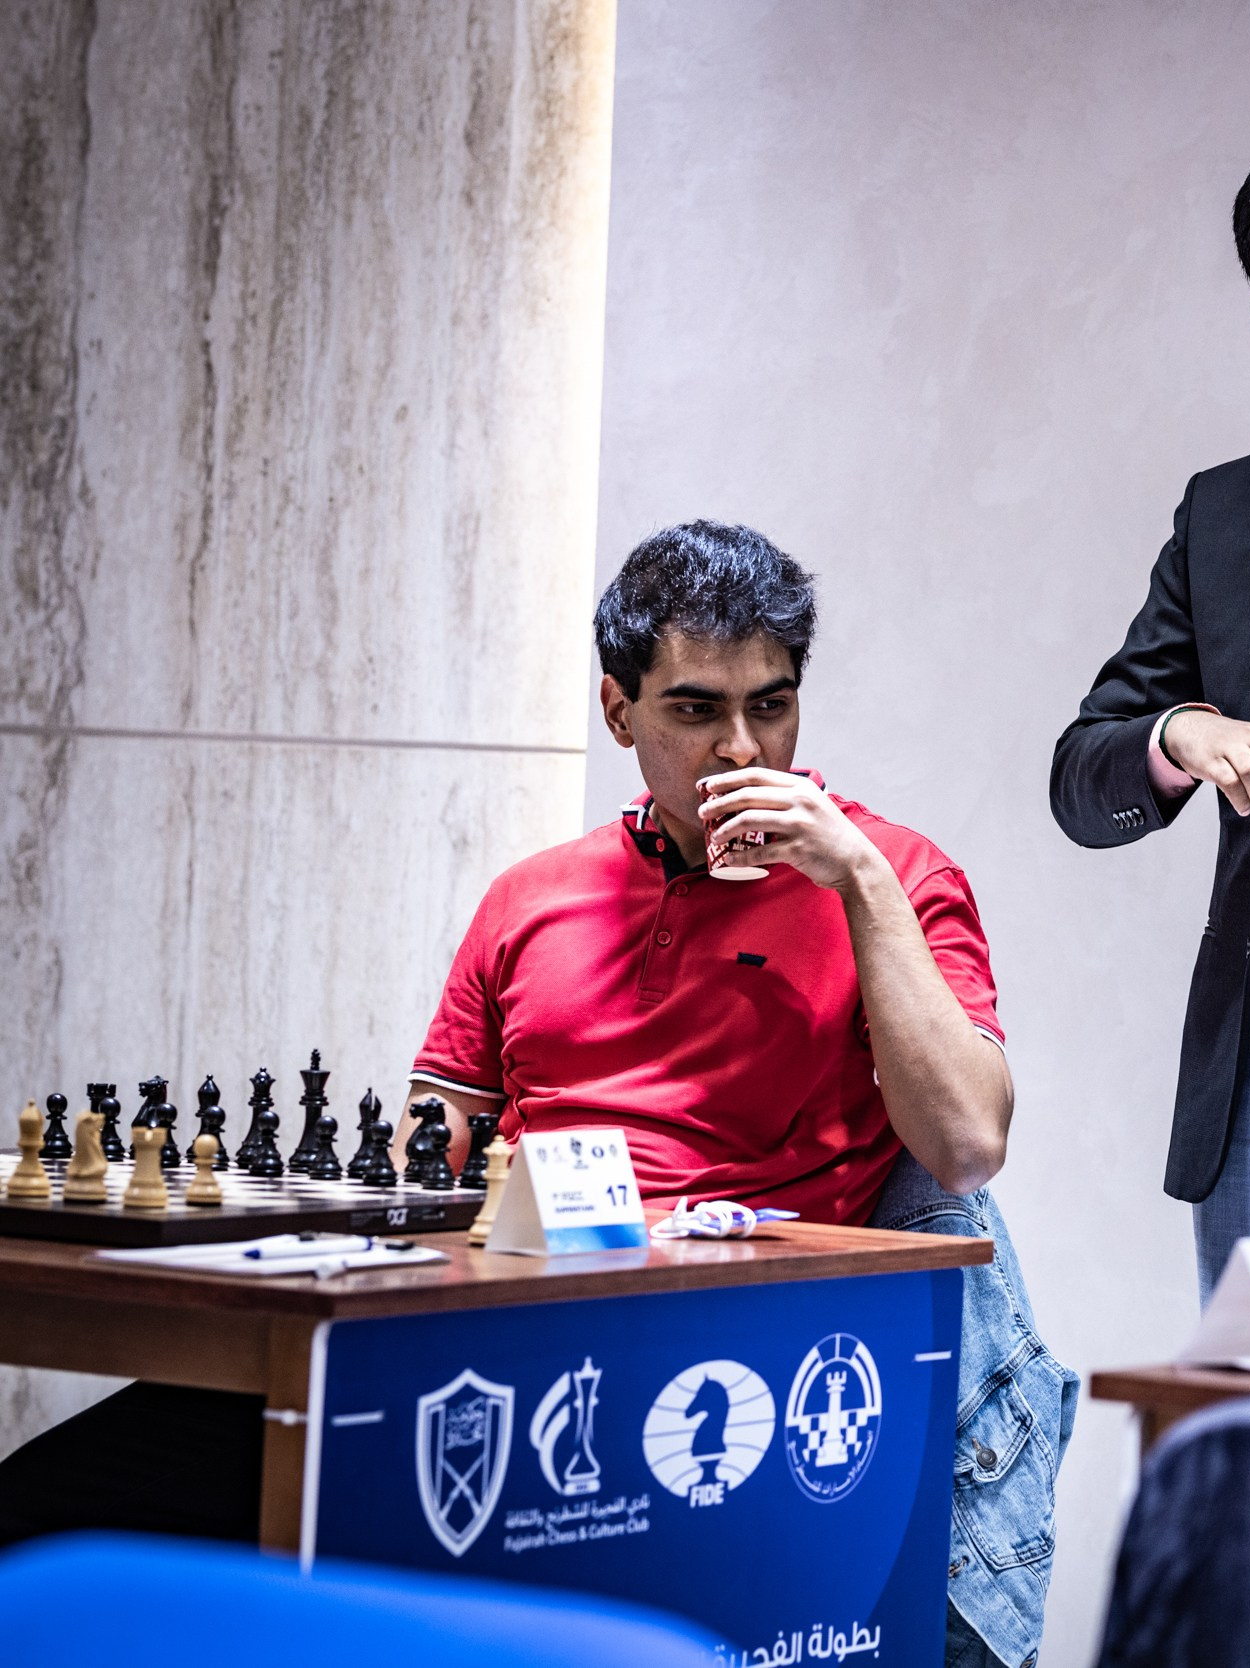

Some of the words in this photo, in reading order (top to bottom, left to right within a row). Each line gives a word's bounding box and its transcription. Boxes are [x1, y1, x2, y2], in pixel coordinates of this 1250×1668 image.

[606, 1185, 627, 1206] 17
[690, 1482, 725, 1508] FIDE
[548, 1529, 578, 1546] Chess
[588, 1522, 625, 1540] Culture
[626, 1516, 650, 1534] Club
[808, 1621, 881, 1663] بطولة
